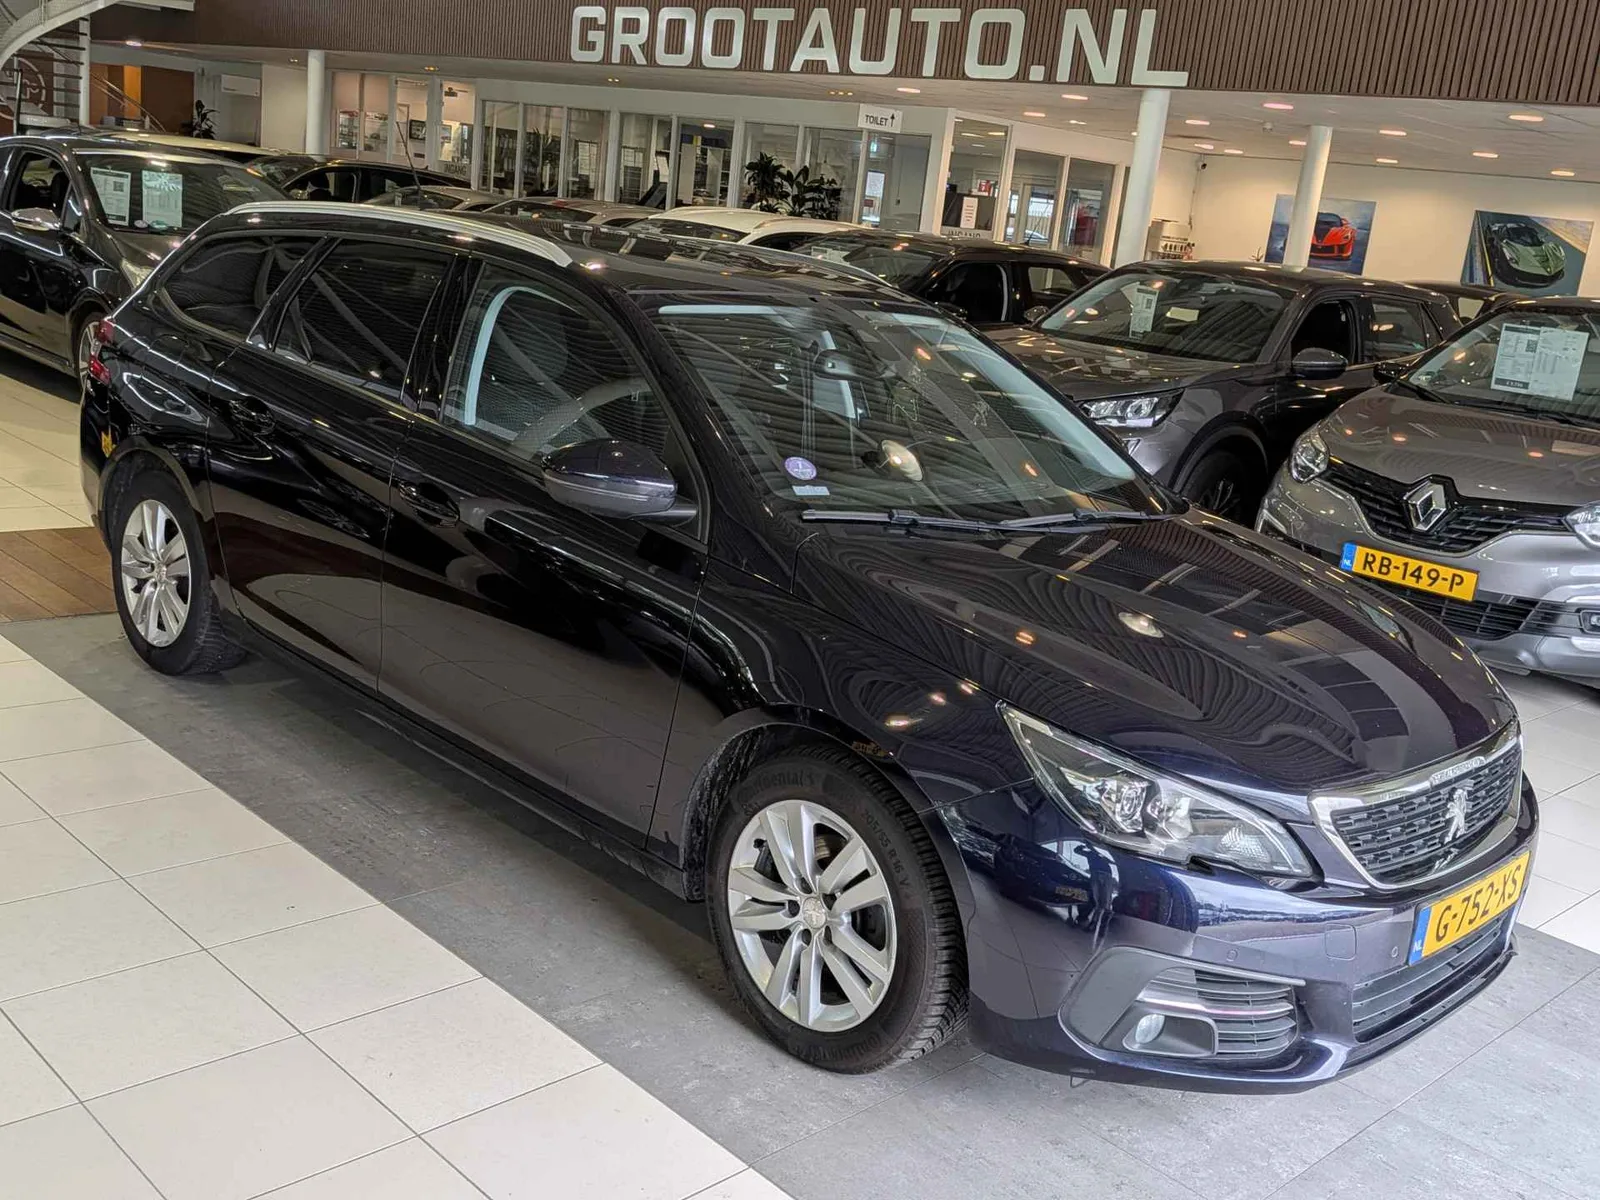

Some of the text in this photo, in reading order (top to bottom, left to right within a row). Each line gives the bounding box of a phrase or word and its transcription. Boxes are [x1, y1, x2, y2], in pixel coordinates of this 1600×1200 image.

[570, 6, 1189, 87] GROOTAUTO.NL
[865, 114, 888, 126] TOILET
[1362, 552, 1465, 593] RB-149-P
[1435, 864, 1521, 942] G-752-XS
